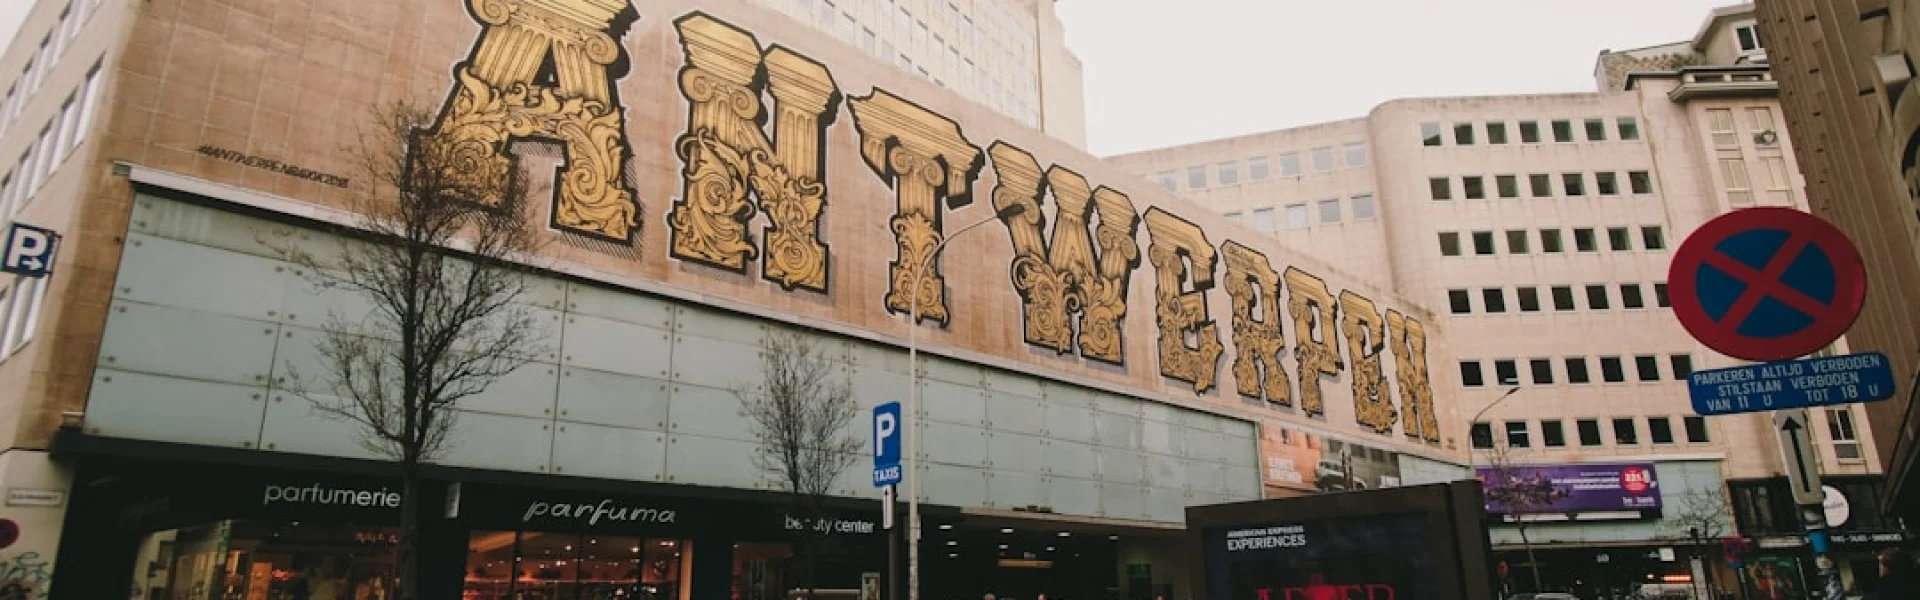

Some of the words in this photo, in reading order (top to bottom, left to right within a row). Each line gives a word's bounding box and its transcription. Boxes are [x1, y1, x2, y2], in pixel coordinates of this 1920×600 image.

[403, 0, 1441, 443] ANTWERPEN
[6, 227, 48, 267] P
[1693, 369, 1755, 385] PARKEREN
[1761, 363, 1803, 379] ALTIJD
[1810, 354, 1880, 374] VERBODEN
[1706, 398, 1732, 412] VAN
[1737, 396, 1749, 409] 11
[1763, 394, 1773, 407] U
[1805, 389, 1829, 403] TOT
[1841, 385, 1858, 399] 18
[1868, 383, 1878, 397] U
[1718, 379, 1782, 397] STILSTAAN
[1789, 372, 1859, 390] VERBODEN
[876, 412, 895, 457] P
[874, 466, 899, 482] TAXIS
[264, 483, 401, 508] parfumerie
[522, 498, 676, 526] parfuma
[835, 519, 875, 534] center
[1227, 533, 1306, 551] EXPERIENCES
